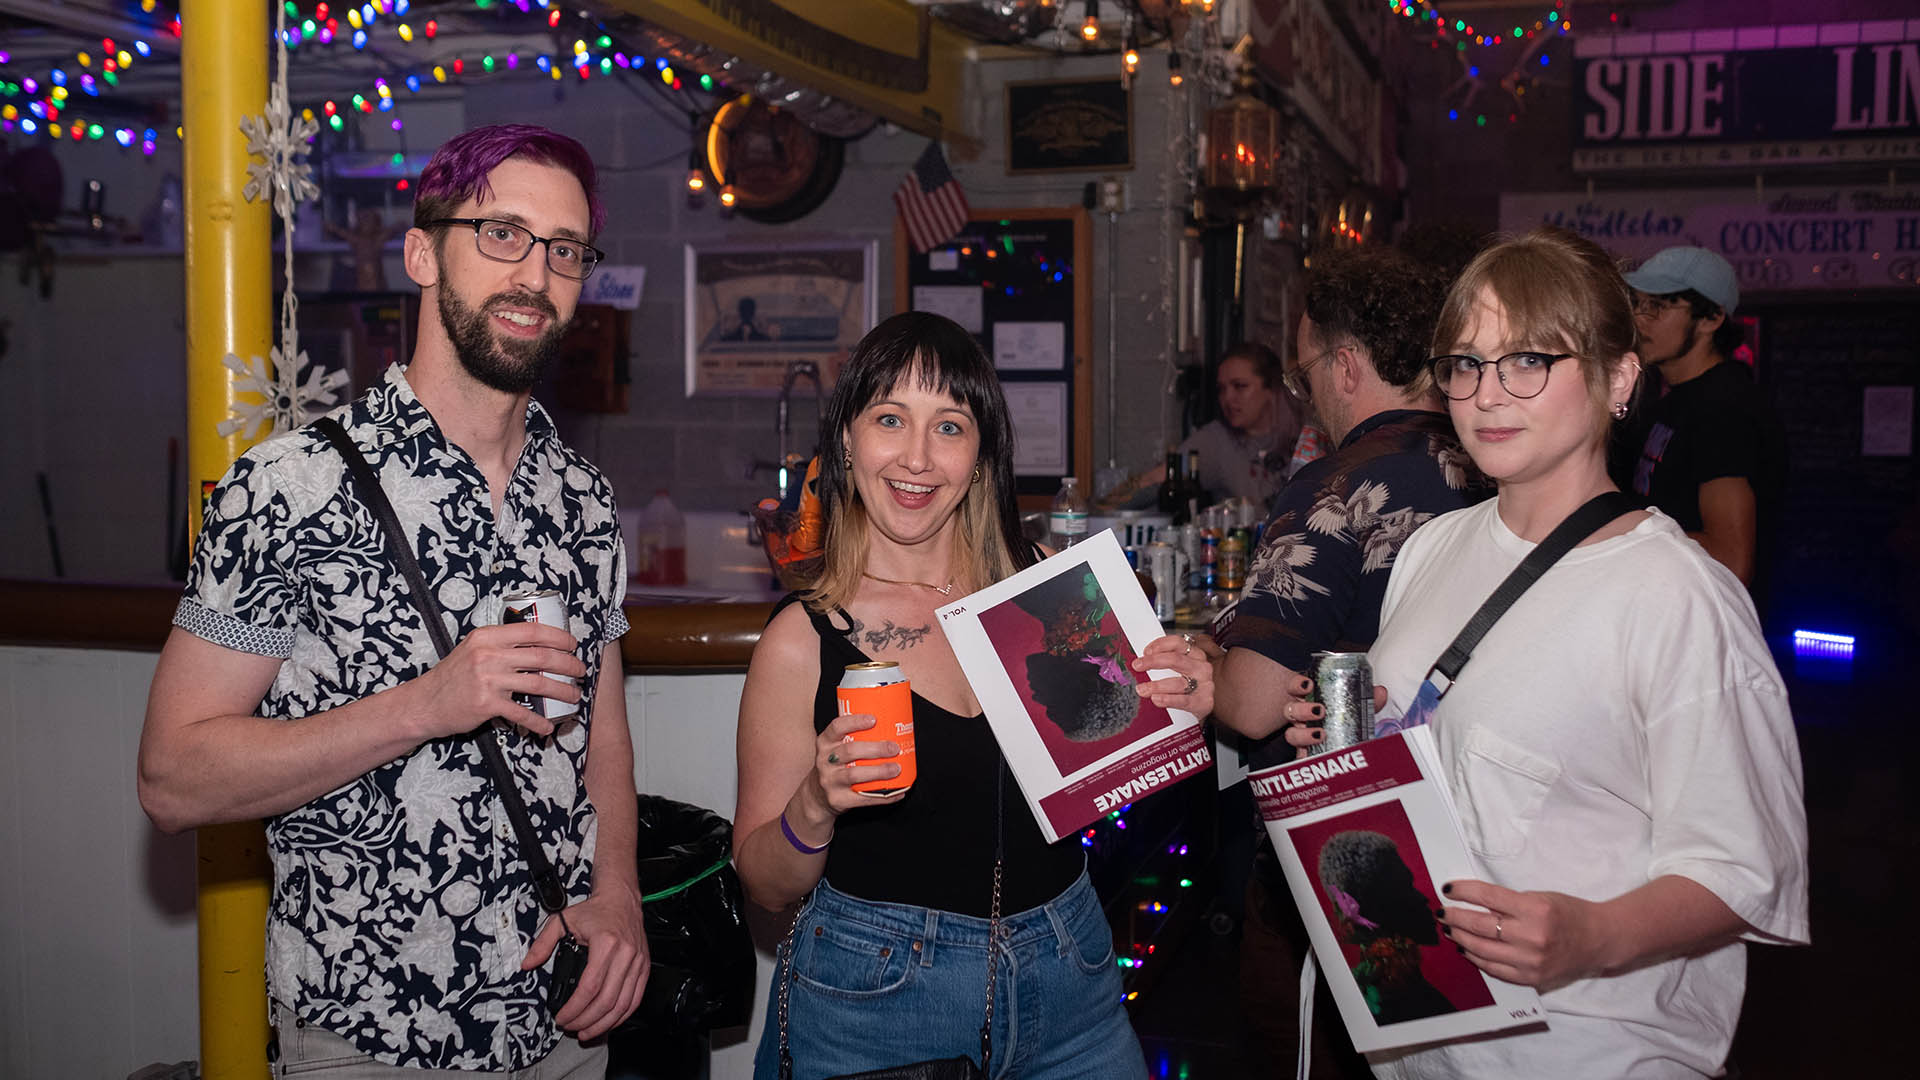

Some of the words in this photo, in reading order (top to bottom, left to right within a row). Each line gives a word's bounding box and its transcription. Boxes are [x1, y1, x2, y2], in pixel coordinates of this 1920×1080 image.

[1584, 54, 1725, 140] SIDE
[1577, 151, 1624, 165] THE
[1750, 144, 1801, 158] BAR
[1817, 143, 1848, 156] AT
[1720, 218, 1873, 255] CONCERT
[1131, 753, 1168, 774] magazine
[1167, 748, 1179, 757] art
[1093, 746, 1211, 813] RATTLESNAKE
[1249, 749, 1369, 797] RATTLESNAKE
[1280, 795, 1291, 804] art
[1291, 784, 1329, 801] magazine
